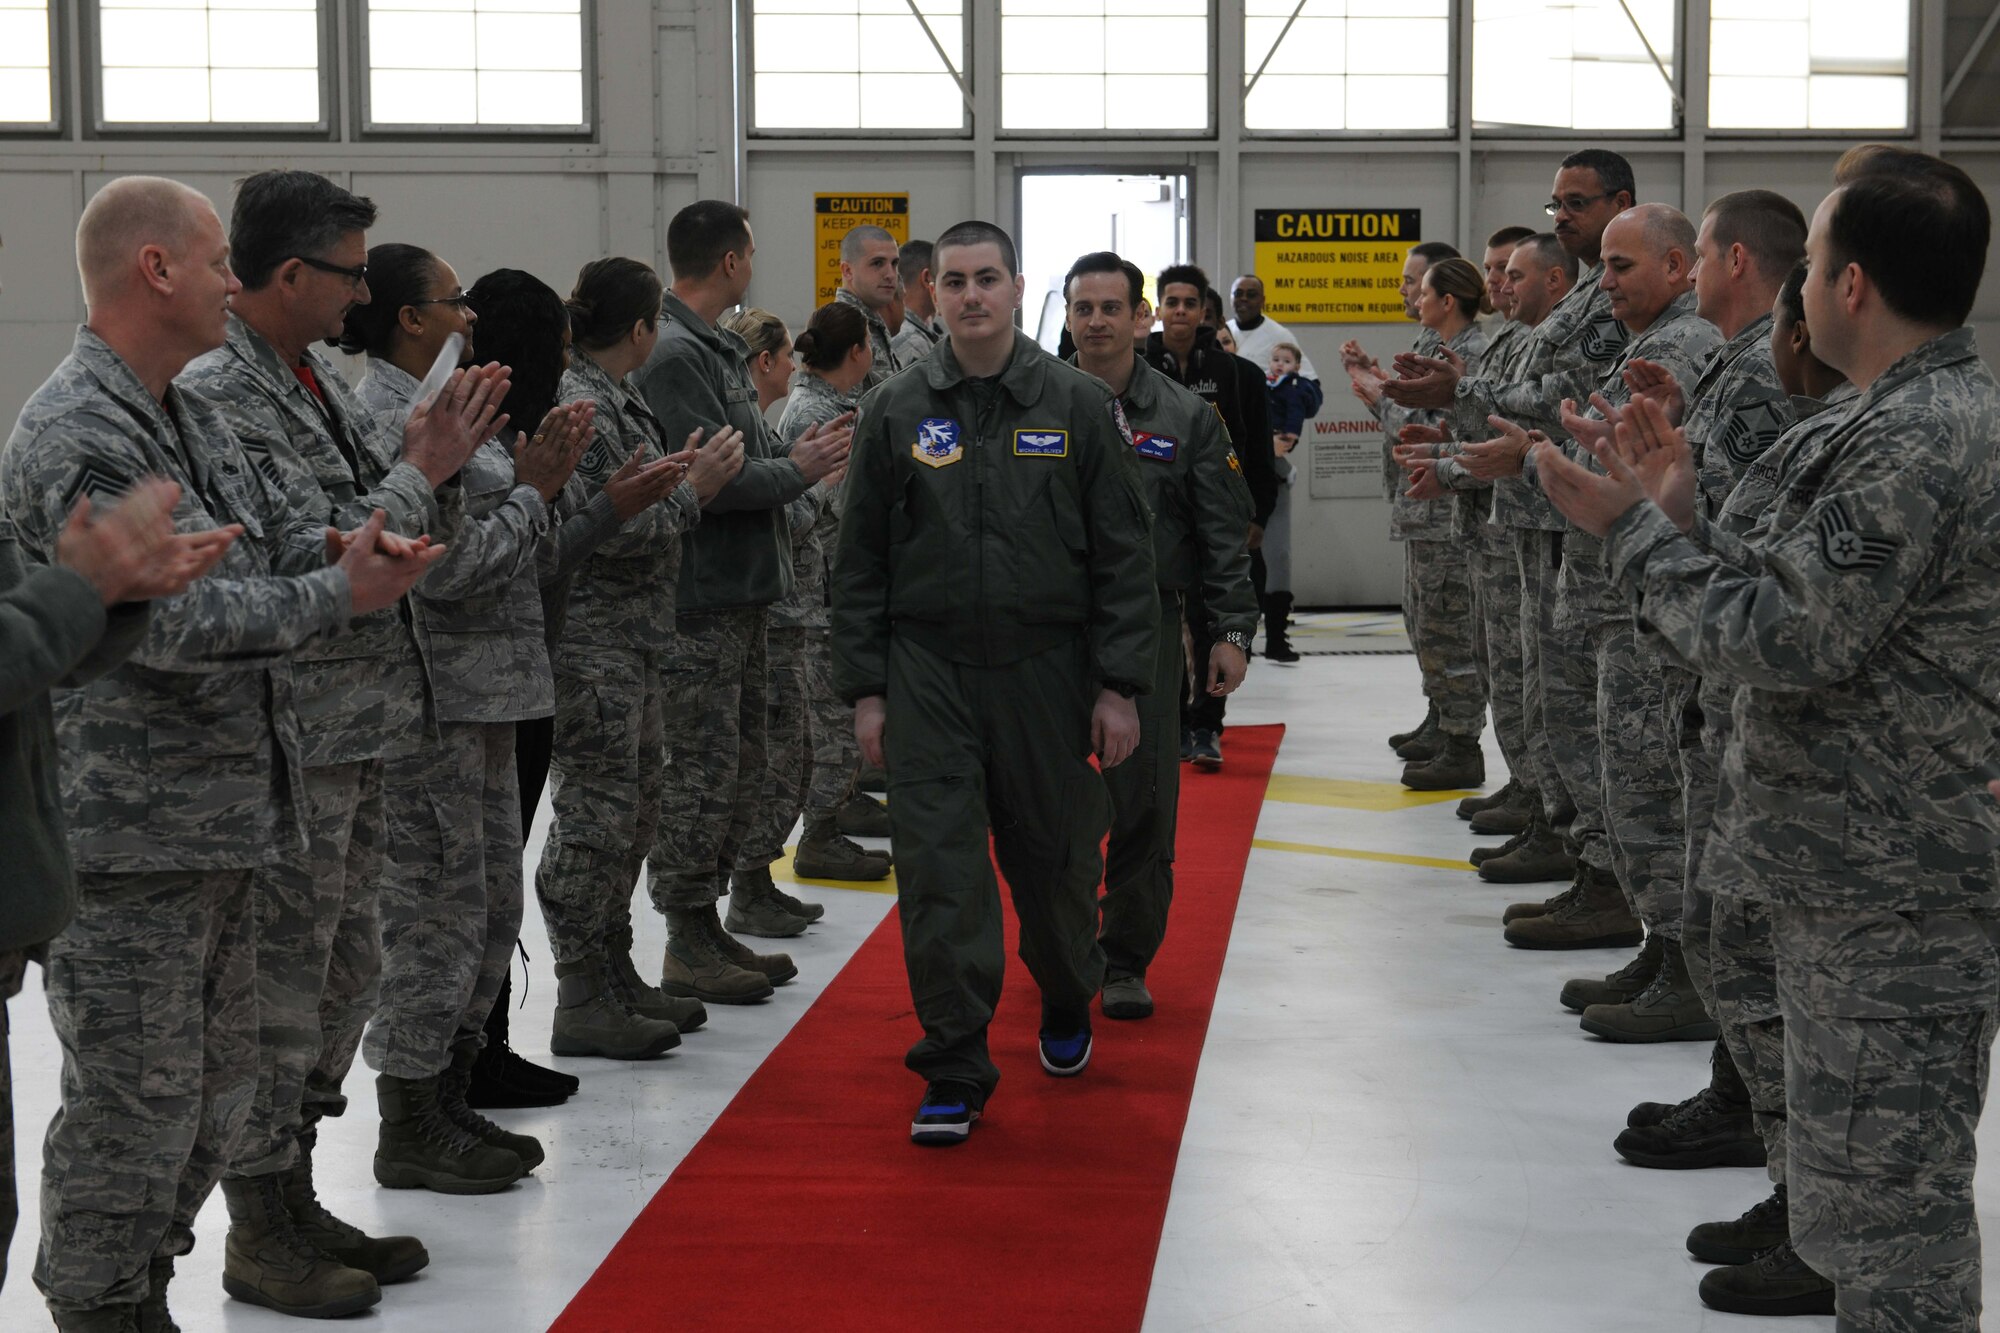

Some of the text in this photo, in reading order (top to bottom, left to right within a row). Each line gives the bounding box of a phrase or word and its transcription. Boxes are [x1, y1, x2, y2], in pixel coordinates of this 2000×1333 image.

[831, 199, 894, 213] CAUTION
[823, 218, 856, 229] KEEP
[1276, 213, 1400, 238] CAUTION
[1277, 252, 1399, 264] HAZARDOUS NOISE AREA
[1275, 278, 1400, 289] MAY CAUSE HEARING LOSS
[1305, 303, 1364, 313] PROTECTION
[1189, 378, 1218, 393] ostale
[1787, 487, 1814, 505] ORC
